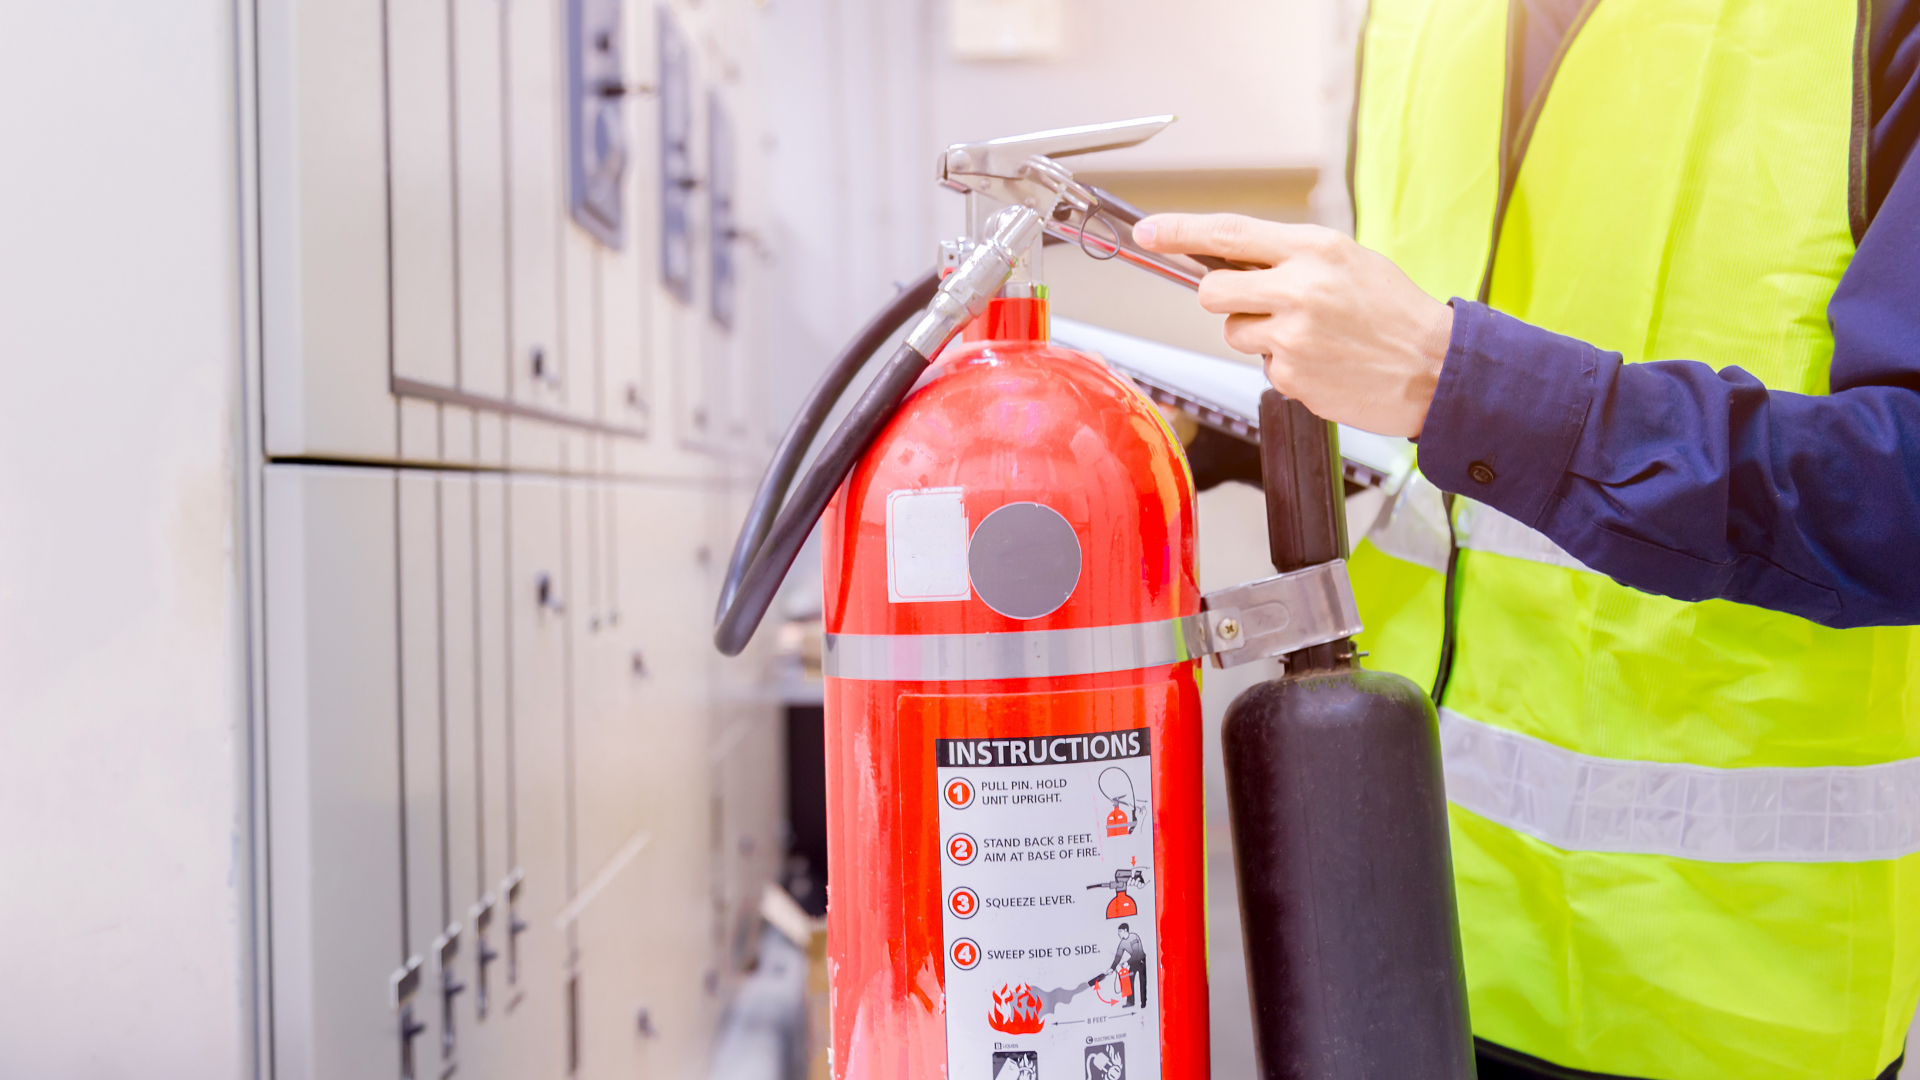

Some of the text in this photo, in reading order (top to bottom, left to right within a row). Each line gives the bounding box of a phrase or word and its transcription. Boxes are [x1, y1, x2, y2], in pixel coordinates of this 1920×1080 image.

[949, 732, 1141, 765] INSTRUCTIONS
[981, 778, 1068, 791] PULL PIN. HOLD
[952, 784, 964, 802] 1
[982, 793, 1062, 805] UNIT UPRIGHT.
[983, 833, 1094, 848] STAND BACK 8 FEET.
[954, 840, 968, 858] 2
[984, 847, 1101, 862] AIM AT BASE OF FIRE.
[956, 894, 970, 911] 3
[985, 895, 1076, 908] SQUEEZE LEVER.
[957, 945, 972, 962] 4
[987, 944, 1101, 960] SWEEP SIDE TO SIDE.
[1092, 1016, 1108, 1024] FEET
